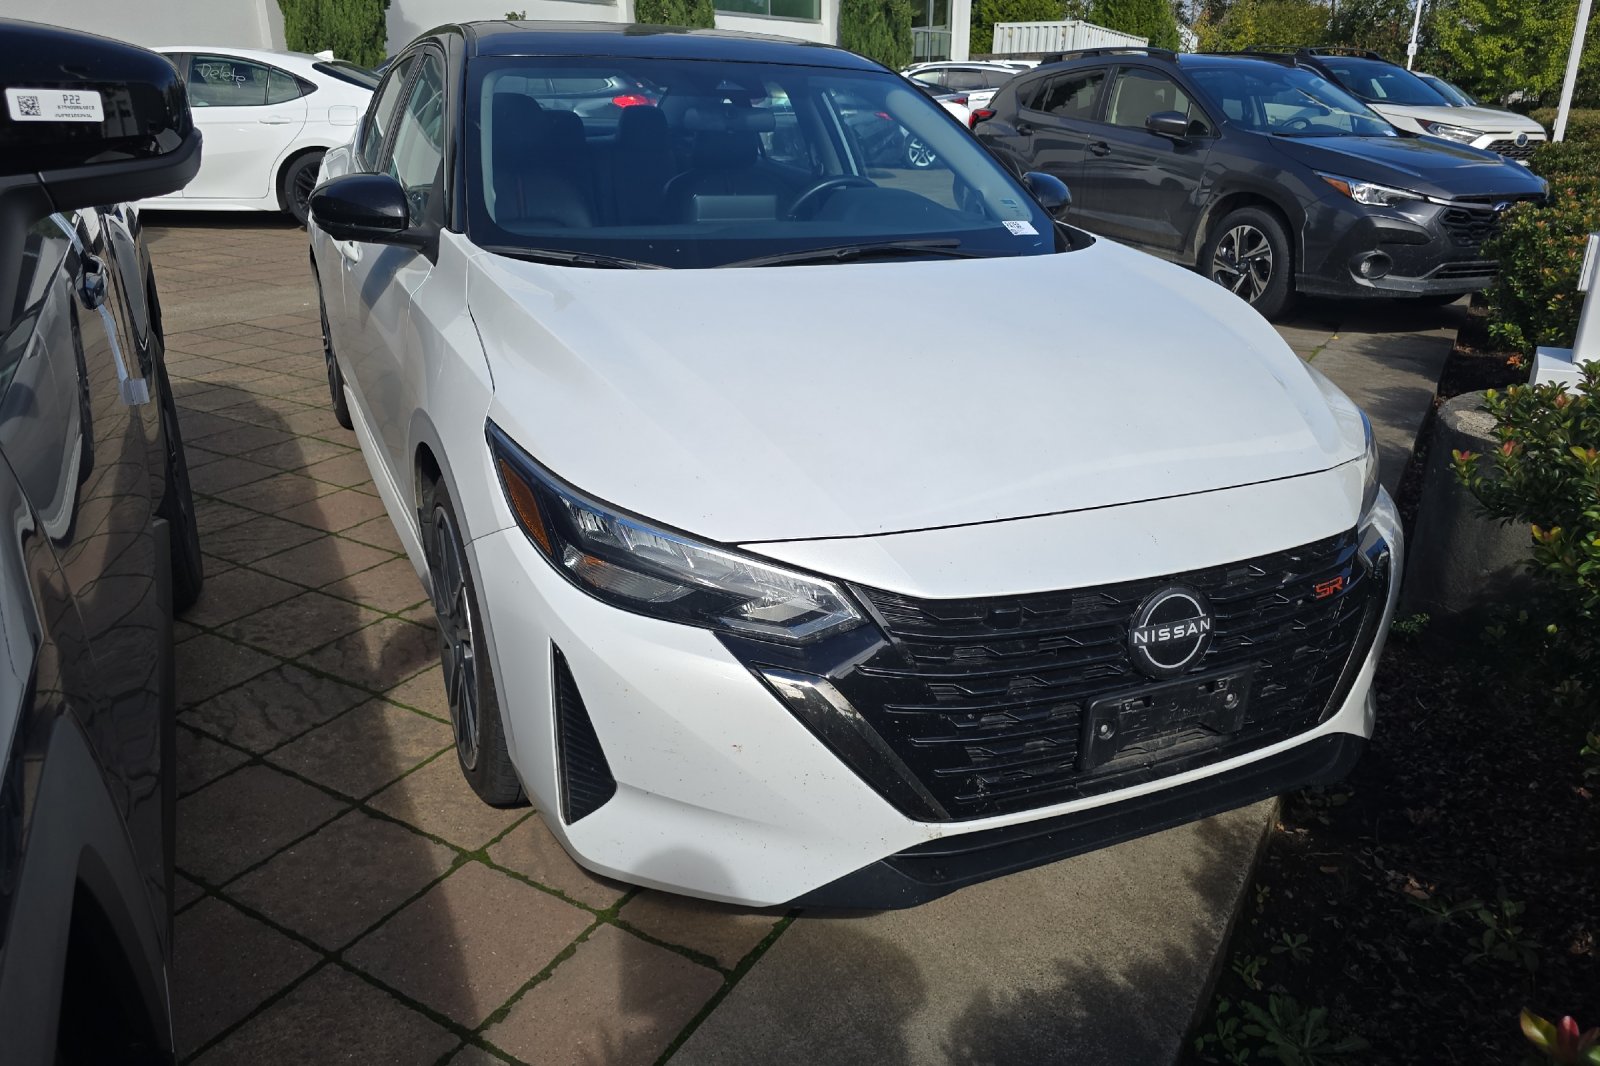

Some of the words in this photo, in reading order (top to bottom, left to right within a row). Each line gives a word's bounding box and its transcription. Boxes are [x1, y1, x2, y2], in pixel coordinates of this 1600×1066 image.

[201, 63, 247, 88] Delete
[63, 94, 81, 104] P22
[1315, 577, 1343, 599] SR
[1134, 617, 1211, 644] NISSAN
